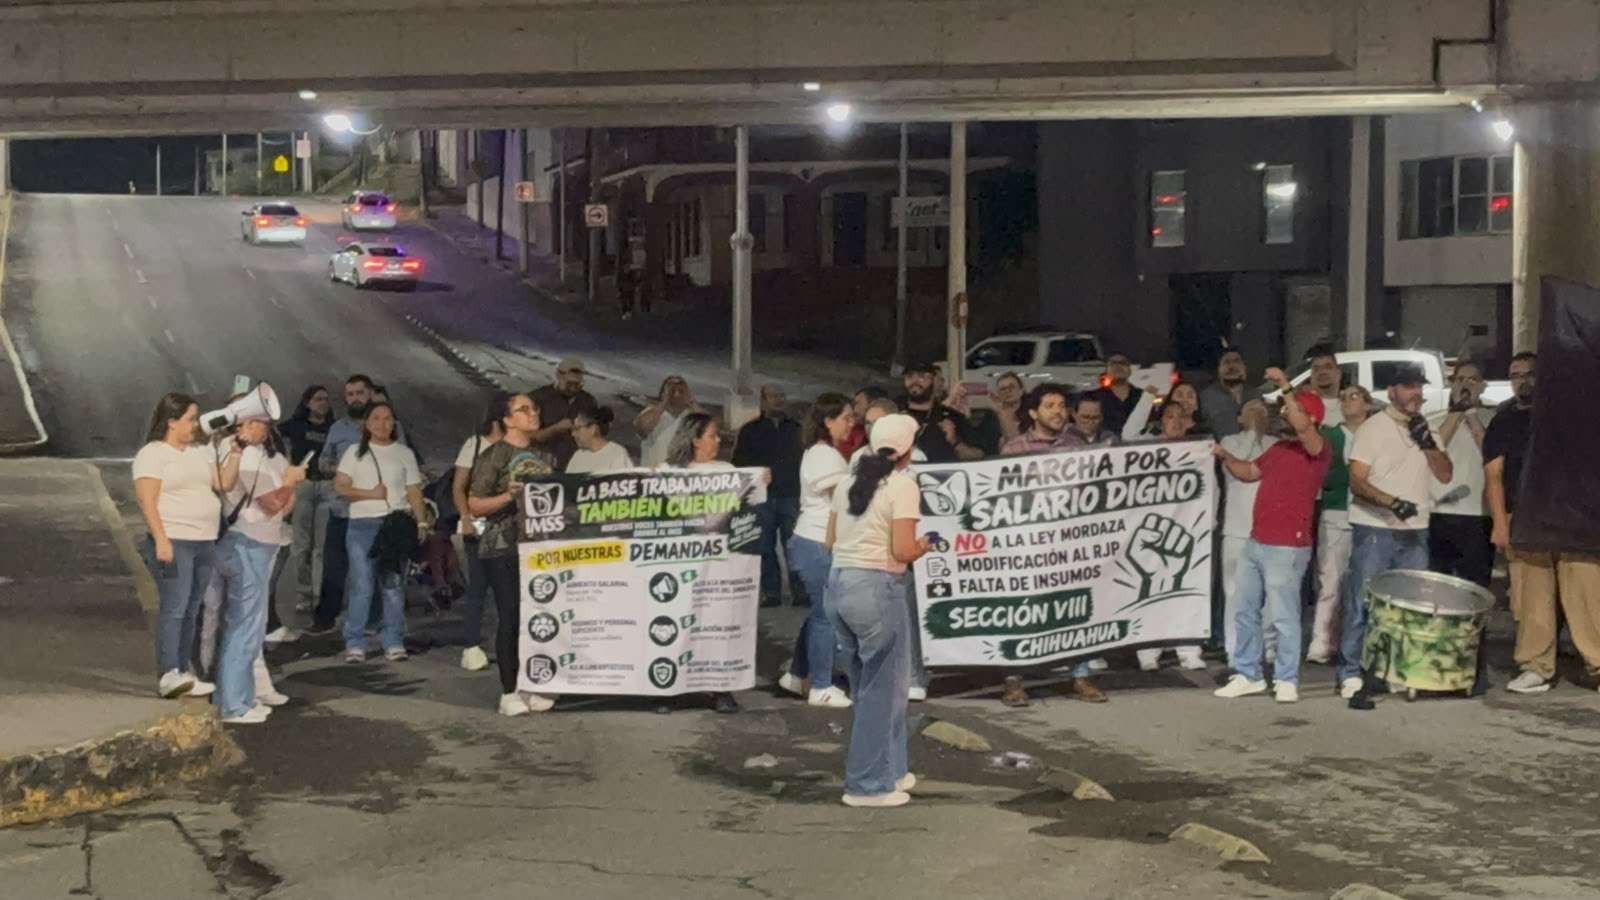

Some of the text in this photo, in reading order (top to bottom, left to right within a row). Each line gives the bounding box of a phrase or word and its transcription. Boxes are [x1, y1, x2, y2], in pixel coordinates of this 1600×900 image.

[998, 448, 1171, 491] MARCHA POR
[577, 472, 741, 502] LA BASE TRABAJADORA
[971, 472, 1198, 530] SALARIO DIGNO
[667, 492, 741, 517] CUENTA
[526, 515, 565, 534] IMSS
[955, 518, 1126, 552] NO A LA LEY MORDAZA
[537, 539, 723, 566] POR NUESTRAS DEMANDAS
[957, 541, 1120, 573] MODIFICACIÓN AL RJP
[959, 565, 1101, 594] FALTA DE INSUMOS
[949, 594, 1088, 630] SECCIÓN VIII
[1015, 622, 1120, 658] CHIHUAHUA
